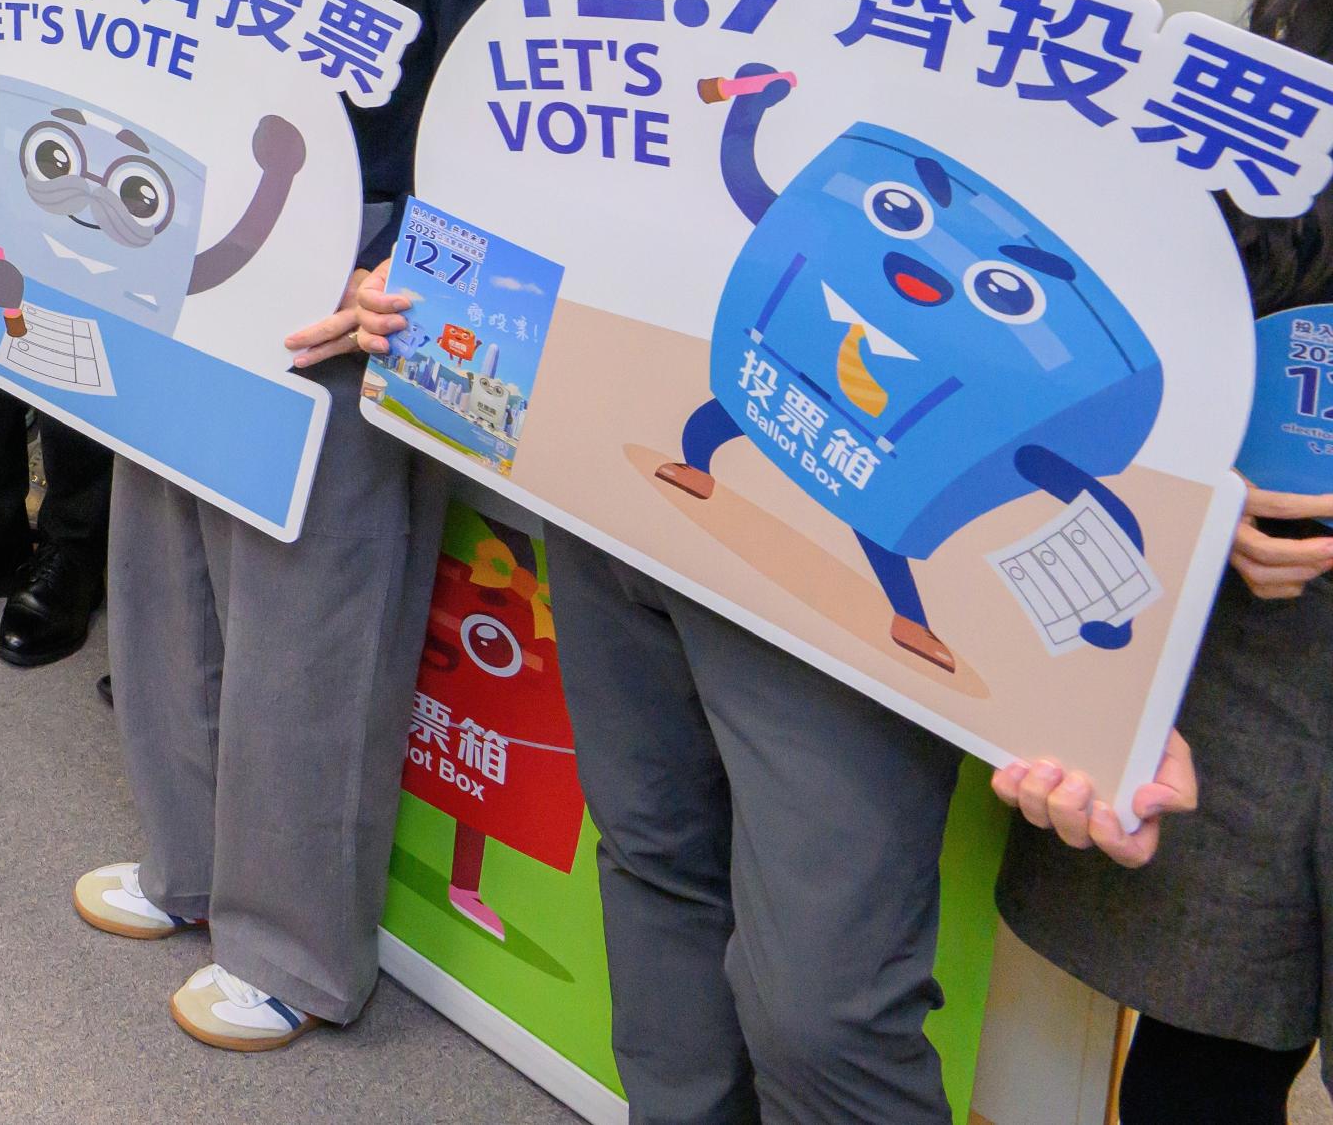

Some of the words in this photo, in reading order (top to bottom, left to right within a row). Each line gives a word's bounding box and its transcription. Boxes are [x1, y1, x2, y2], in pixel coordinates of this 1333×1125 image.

[76, 11, 200, 81] VOTE
[487, 38, 663, 99] LET'S
[487, 100, 672, 168] VOTE
[738, 348, 881, 491] 投票箱
[746, 400, 798, 459] Ballot
[800, 450, 843, 497] Box
[438, 761, 486, 802] Box
